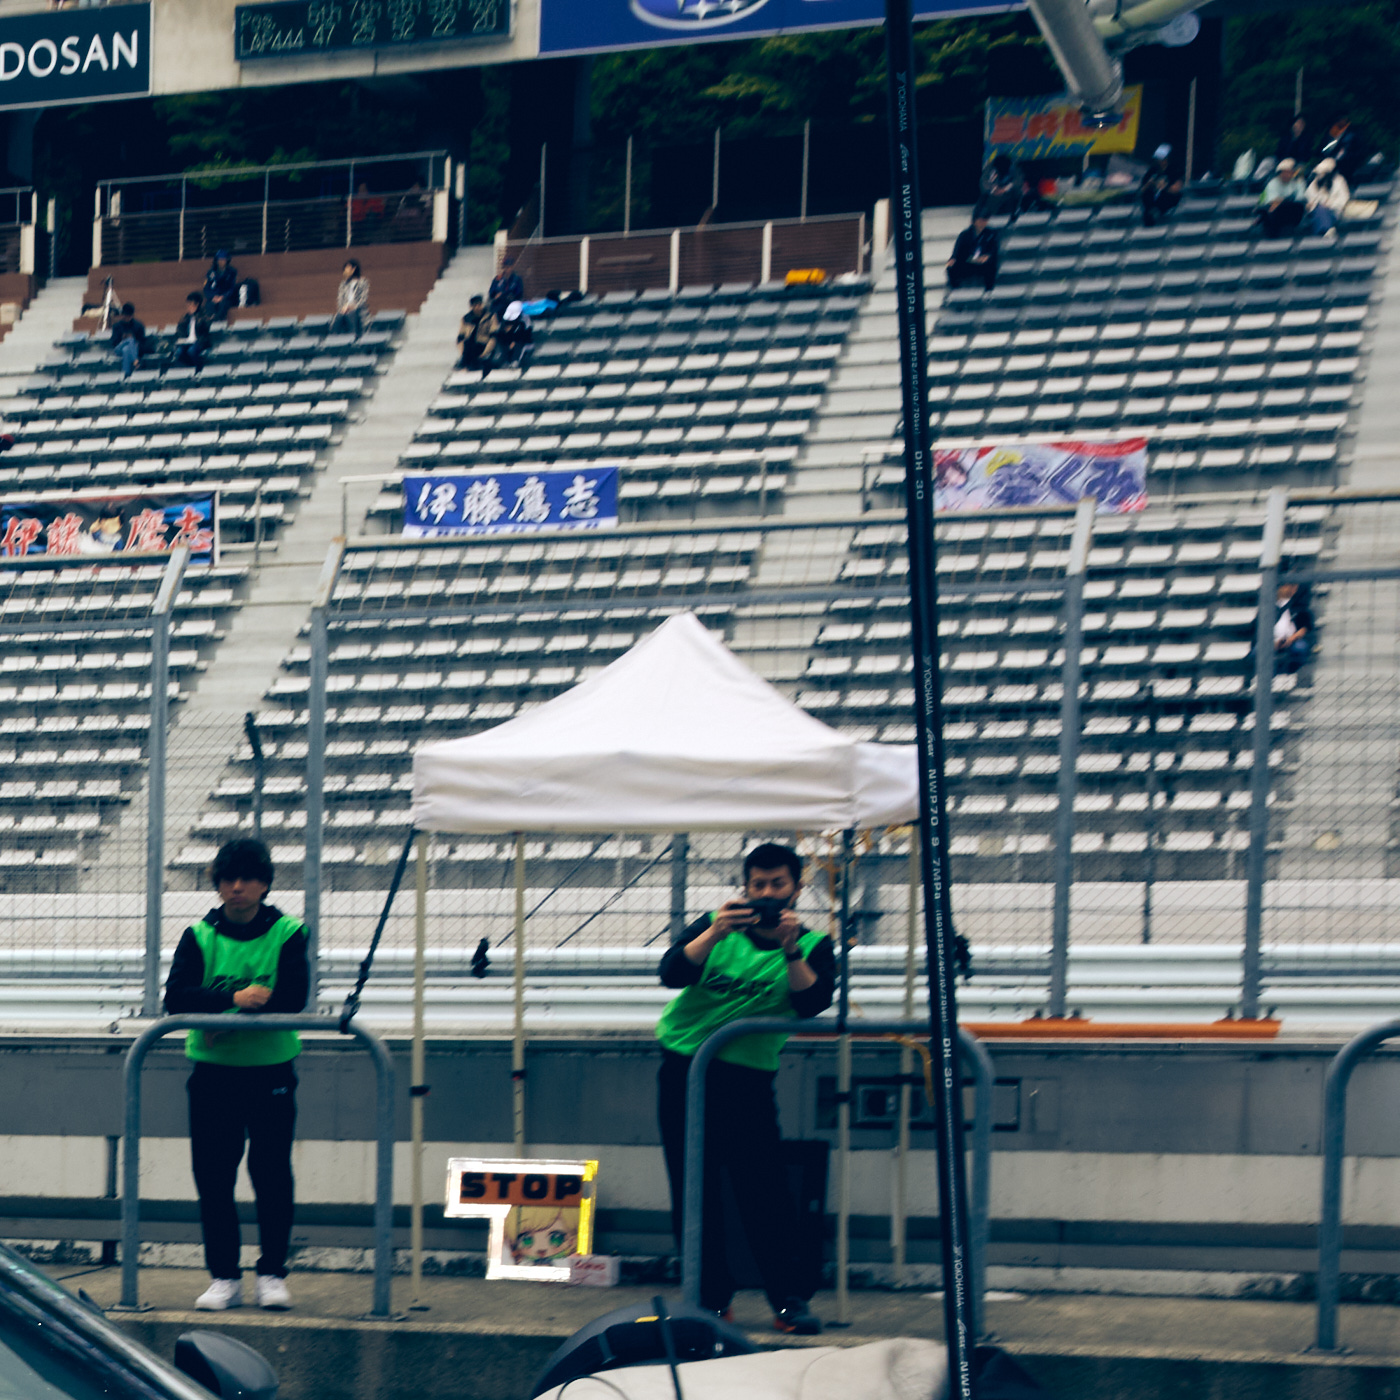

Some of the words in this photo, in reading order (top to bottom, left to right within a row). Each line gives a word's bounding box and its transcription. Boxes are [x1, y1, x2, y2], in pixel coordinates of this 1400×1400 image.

[902, 184, 912, 241] NWP70
[905, 251, 913, 262] 9
[906, 272, 915, 313] 7MPa
[914, 451, 924, 470] DH
[416, 476, 600, 526] 伊藤鷹志
[915, 480, 924, 500] 30
[923, 668, 933, 715] YOKOHAMA
[928, 768, 938, 827] NWP70
[931, 837, 939, 846] 9
[932, 857, 941, 900] 7MPa
[942, 1038, 951, 1058] DH
[944, 1067, 953, 1088] 30
[460, 1171, 581, 1201] STOP
[955, 1259, 964, 1307] YOKOHAMA
